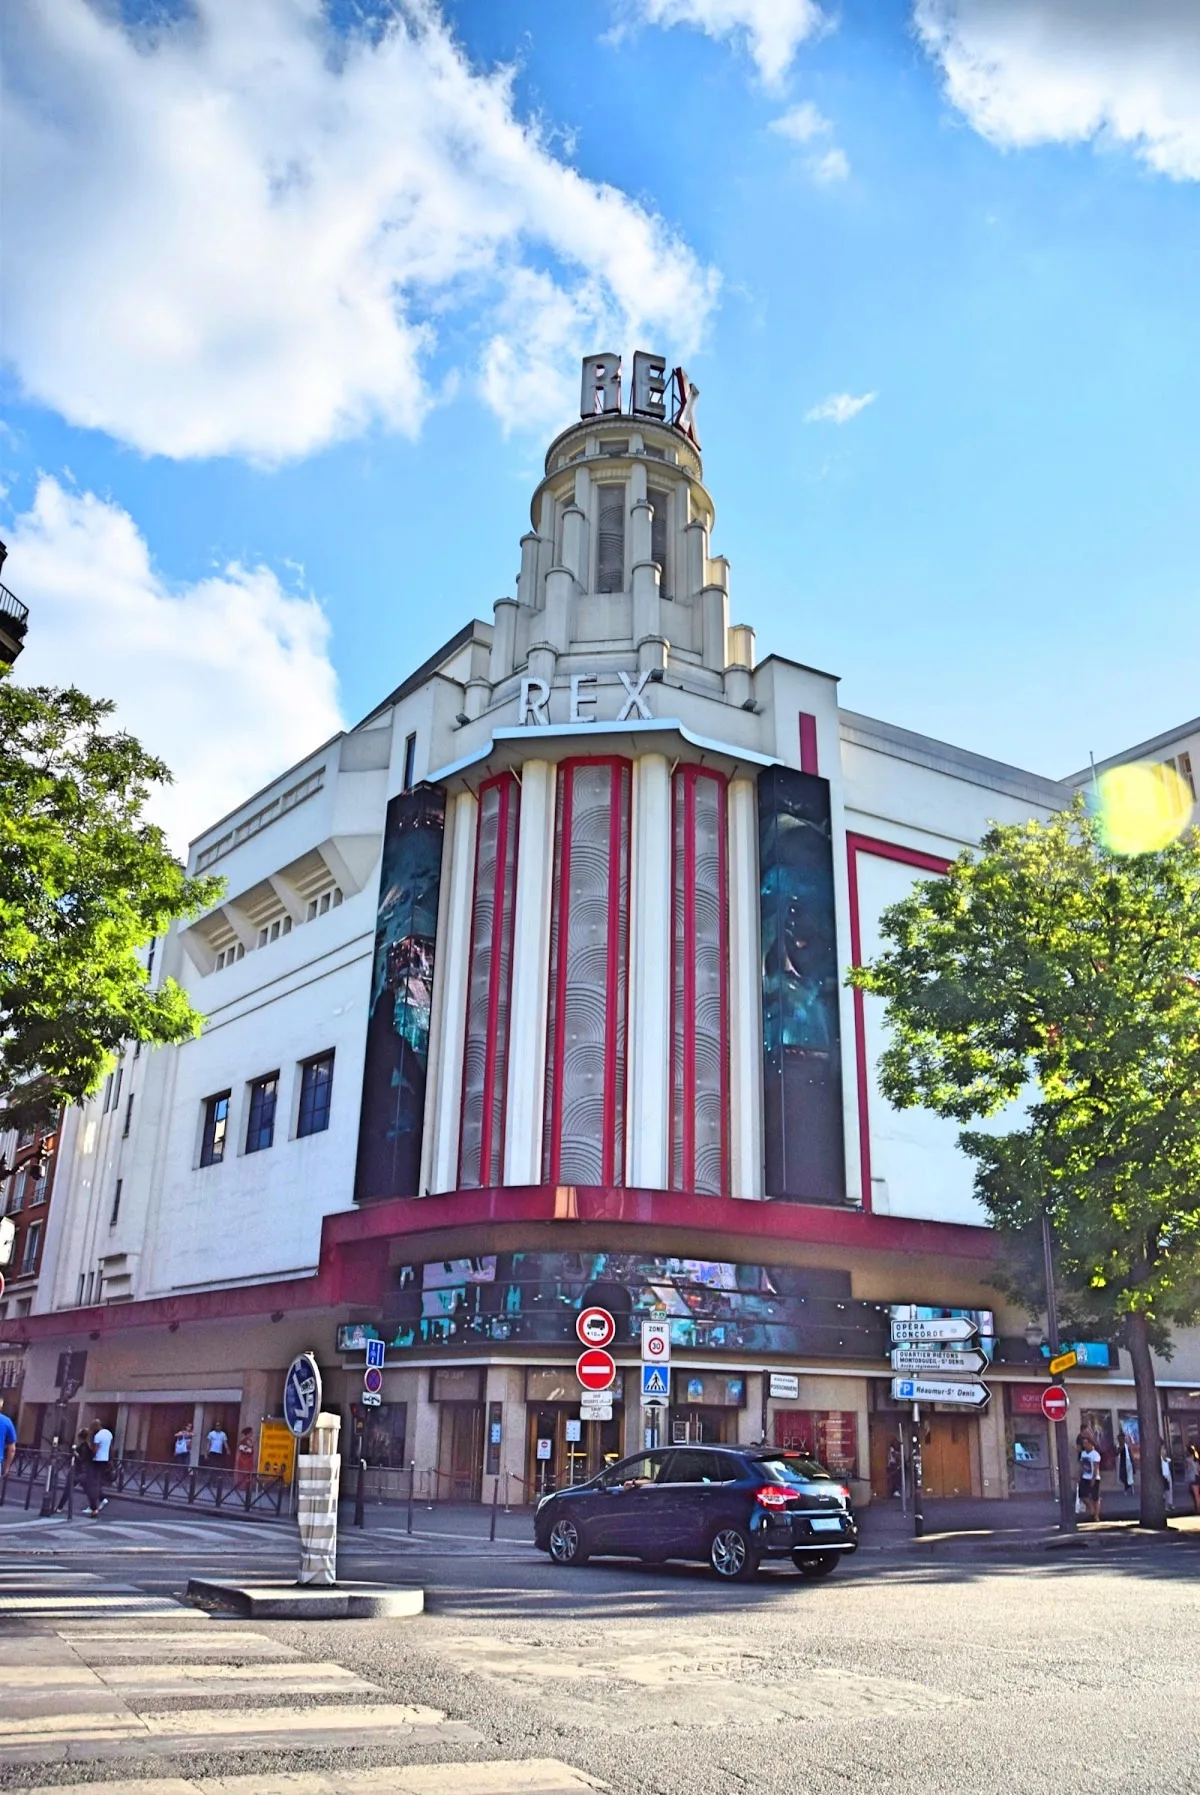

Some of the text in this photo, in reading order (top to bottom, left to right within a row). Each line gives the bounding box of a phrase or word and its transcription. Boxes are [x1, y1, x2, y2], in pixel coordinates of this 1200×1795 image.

[580, 350, 701, 451] REX
[518, 670, 654, 726] REX
[896, 1330, 944, 1338] CONCORDE
[652, 1342, 660, 1350] 30
[957, 1389, 975, 1397] Denis
